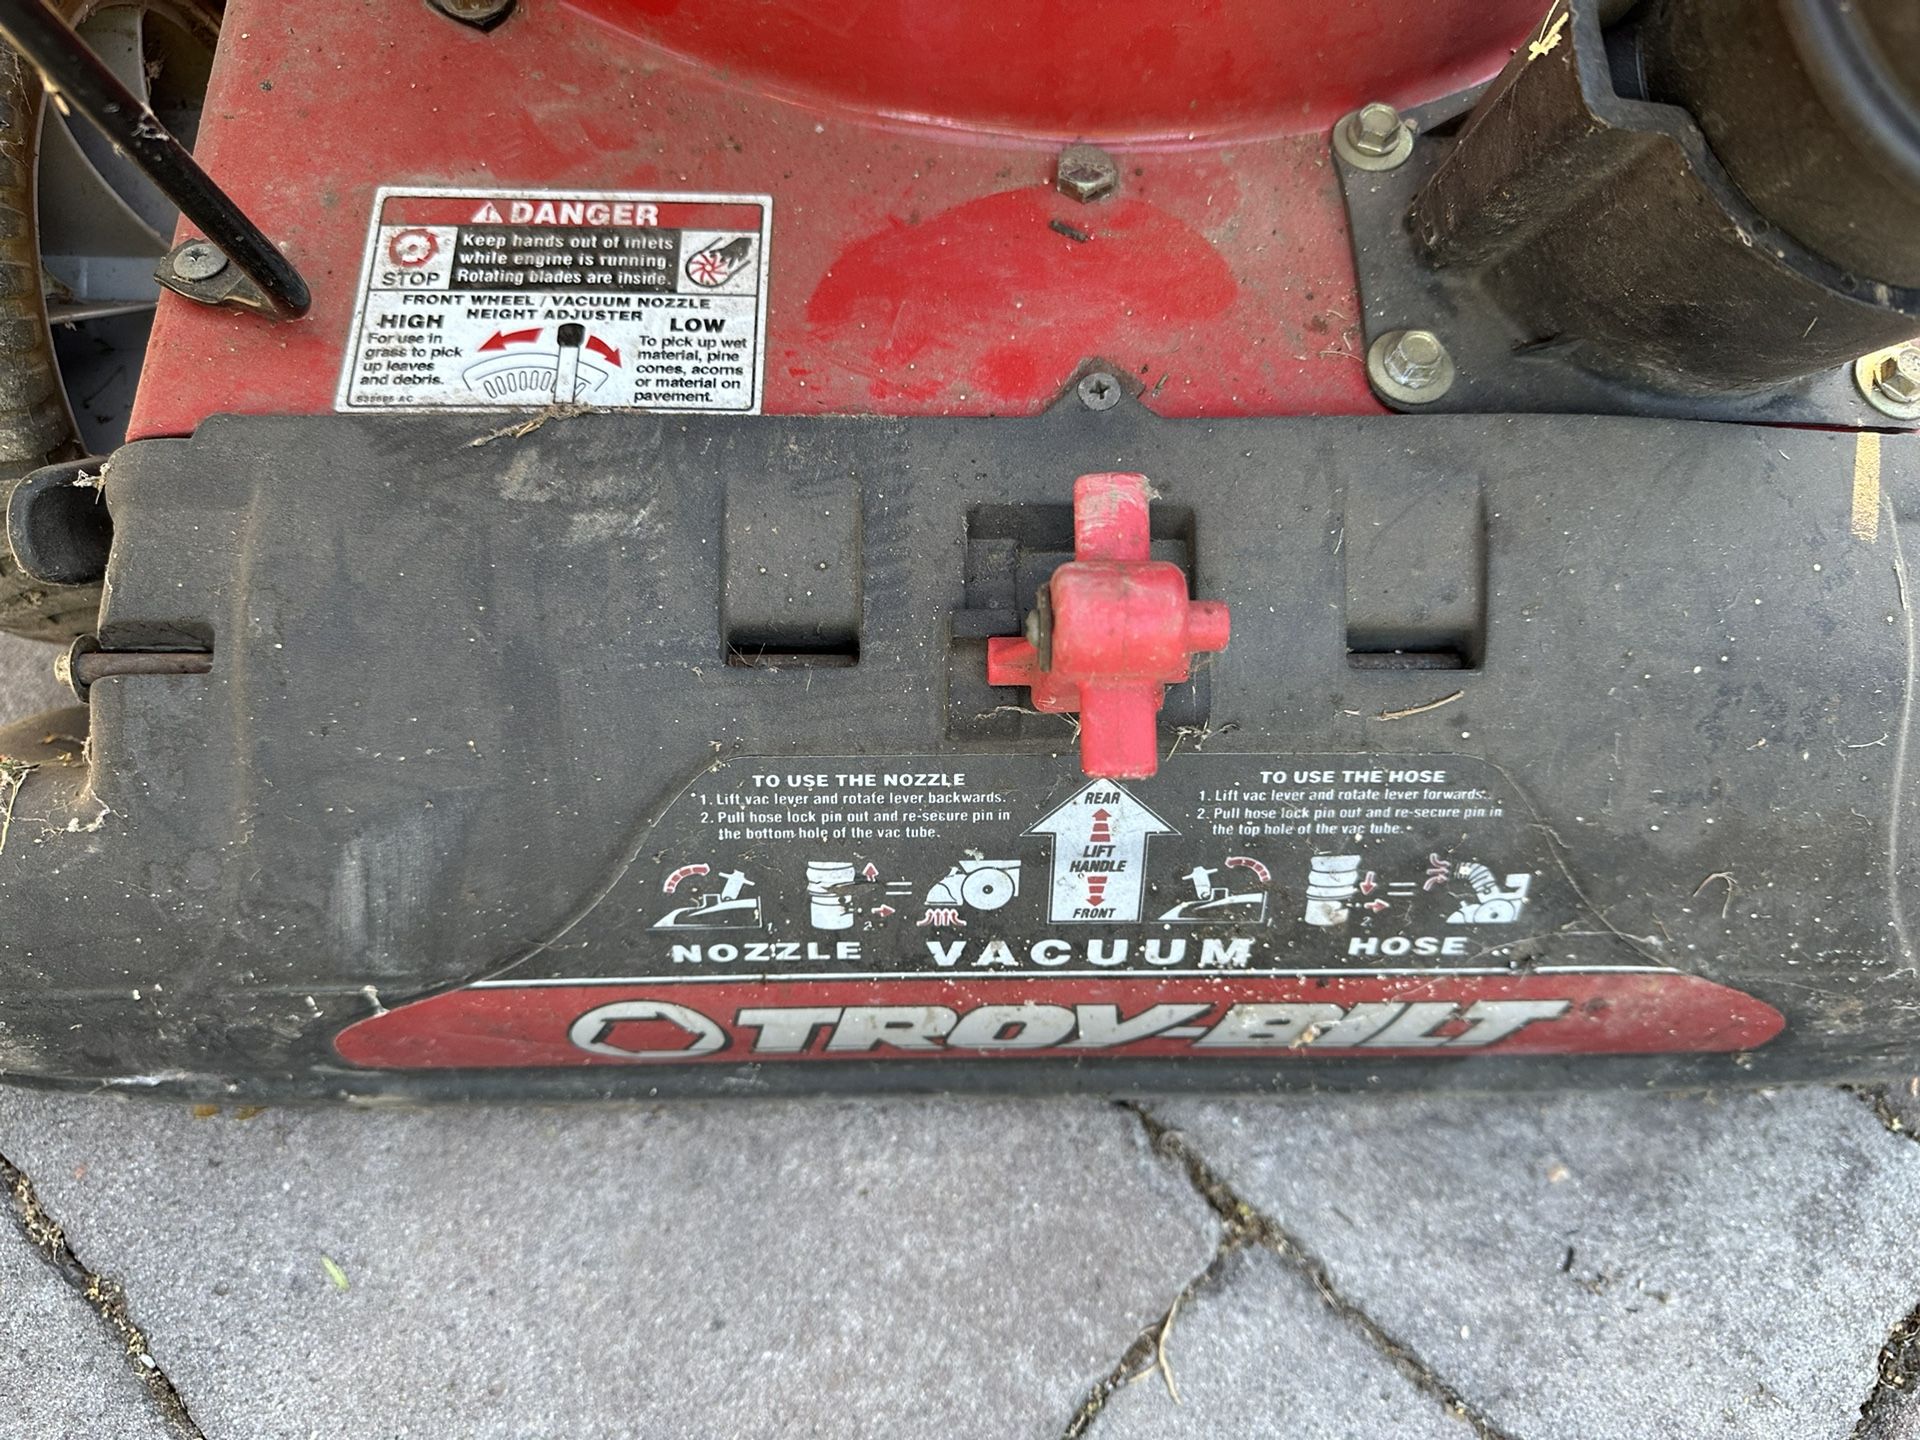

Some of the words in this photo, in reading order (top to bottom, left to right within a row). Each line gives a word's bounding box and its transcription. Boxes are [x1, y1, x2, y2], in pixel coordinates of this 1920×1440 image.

[510, 202, 659, 226] DANGER
[463, 234, 506, 249] Keep
[512, 235, 564, 248] hands
[570, 236, 597, 248] out
[603, 236, 619, 249] of
[625, 237, 674, 250] inlets
[459, 252, 507, 265] while
[514, 253, 573, 268] engine
[579, 253, 594, 266] is
[600, 255, 673, 269] running.
[382, 272, 440, 286] STOP
[457, 270, 524, 286] Rotating
[529, 270, 582, 283] blades
[587, 273, 612, 284] are
[618, 271, 672, 286] inside.
[402, 294, 465, 305] FRONT
[470, 295, 534, 306] WHEEL
[551, 296, 631, 308] VACUUM
[637, 297, 711, 309] NOZZLE
[379, 314, 445, 329] HIGH
[467, 309, 538, 320] HEIGHT
[544, 309, 643, 321] ADJUSTER
[670, 318, 725, 333] LOW
[367, 333, 395, 344] For
[397, 335, 425, 344] use
[428, 333, 443, 344] in
[639, 335, 657, 347] To
[661, 336, 693, 350] pick
[697, 338, 717, 350] up
[721, 337, 747, 349] wet
[364, 348, 407, 360] grass
[412, 347, 427, 357] to
[430, 347, 463, 360] pick
[637, 350, 702, 362] material,
[707, 351, 740, 364] pine
[363, 363, 382, 374] up
[386, 361, 435, 371] leaves
[636, 365, 687, 376] cones,
[691, 366, 744, 376] acorns
[360, 375, 388, 385] and
[393, 375, 445, 385] debris.
[635, 378, 650, 388] or
[655, 378, 716, 389] material
[721, 379, 741, 389] on
[634, 391, 713, 403] pavement.
[752, 775, 780, 788] TO
[787, 774, 829, 788] USE
[835, 774, 877, 787] THE
[884, 773, 966, 787] NOZZLE
[1260, 771, 1287, 784] TO
[1293, 771, 1335, 784] USE
[1342, 770, 1383, 783] THE
[1388, 770, 1446, 783] HOSE
[700, 794, 713, 805] 1.
[716, 794, 740, 805] Lift
[745, 795, 770, 805] vac
[774, 793, 809, 804] lever
[813, 793, 838, 804] and
[842, 792, 885, 804] rotate
[889, 792, 924, 804] lever
[928, 792, 1006, 803] backwards.
[1084, 792, 1121, 805] REAR
[1199, 790, 1211, 801] 1.
[1215, 789, 1238, 801] Lift
[1243, 791, 1267, 801] vac
[1271, 789, 1305, 800] lever
[1308, 789, 1334, 800] and
[1338, 789, 1380, 800] rotate
[1384, 788, 1419, 800] lever
[700, 812, 714, 823] 2.
[718, 811, 745, 823] Pull
[750, 812, 782, 823] hose
[787, 811, 816, 822] lock
[821, 811, 842, 825] pin
[847, 811, 869, 822] out
[873, 810, 898, 822] and
[902, 811, 968, 822] re-secure
[972, 810, 994, 823] pin
[998, 809, 1010, 821] in
[1214, 807, 1240, 819] Pull
[1244, 808, 1277, 819] hose
[1281, 807, 1309, 818] lock
[1314, 807, 1335, 821] pin
[1340, 807, 1362, 818] out
[1365, 807, 1391, 818] and
[1395, 807, 1460, 818] re-secure
[1464, 807, 1485, 820] pin
[1489, 807, 1503, 817] in
[718, 828, 741, 840] the
[746, 828, 795, 839] bottom
[799, 828, 828, 839] hole
[833, 828, 846, 838] of
[851, 827, 873, 838] the
[877, 828, 900, 838] vac
[906, 827, 941, 838] tube.
[1212, 824, 1234, 835] the
[1239, 824, 1260, 837] top
[1264, 824, 1293, 835] hole
[1297, 823, 1312, 834] of
[1316, 823, 1338, 834] the
[1342, 824, 1366, 834] vac
[1370, 823, 1404, 834] tube.
[1083, 845, 1116, 858] LIFT
[1069, 860, 1127, 873] HANDLE
[1073, 908, 1116, 919] FRONT
[671, 942, 862, 963] NOZZLE
[926, 938, 1255, 967] VACUUM
[1348, 936, 1468, 956] HOSE
[735, 1000, 1573, 1053] TROY-BILT
